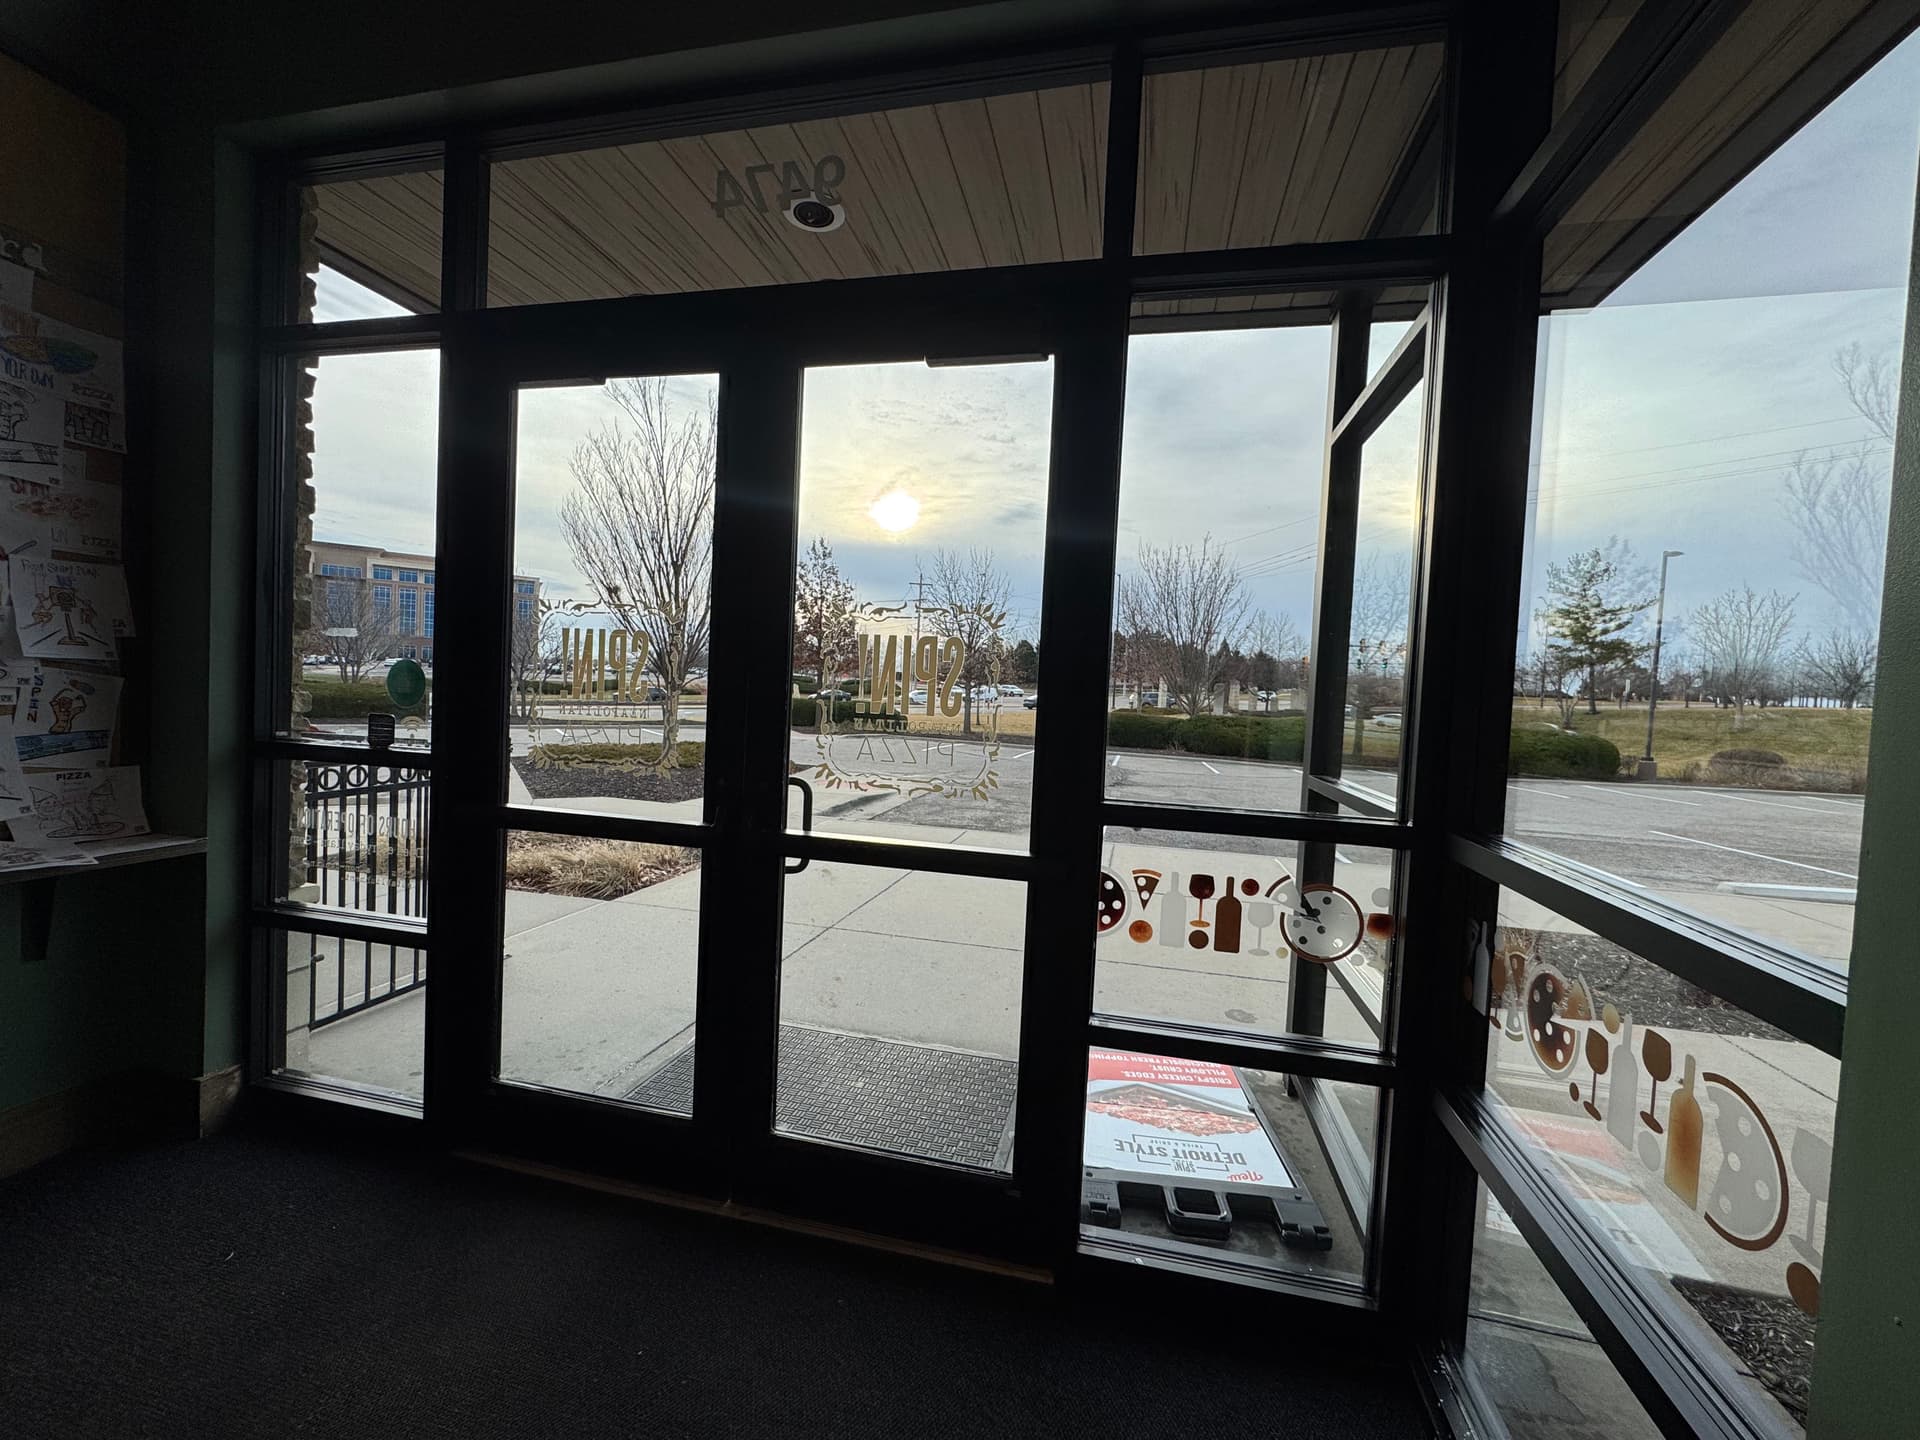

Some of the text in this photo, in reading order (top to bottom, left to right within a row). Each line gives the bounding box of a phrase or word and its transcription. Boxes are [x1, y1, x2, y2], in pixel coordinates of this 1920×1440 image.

[1130, 1055, 1161, 1064] FRESH
[1184, 1066, 1226, 1076] PILLOWY
[1120, 1070, 1232, 1085] CRISPY, CHEESY EDGES.
[1113, 1138, 1248, 1166] DETROIT STYLE
[1226, 1170, 1264, 1182] New
